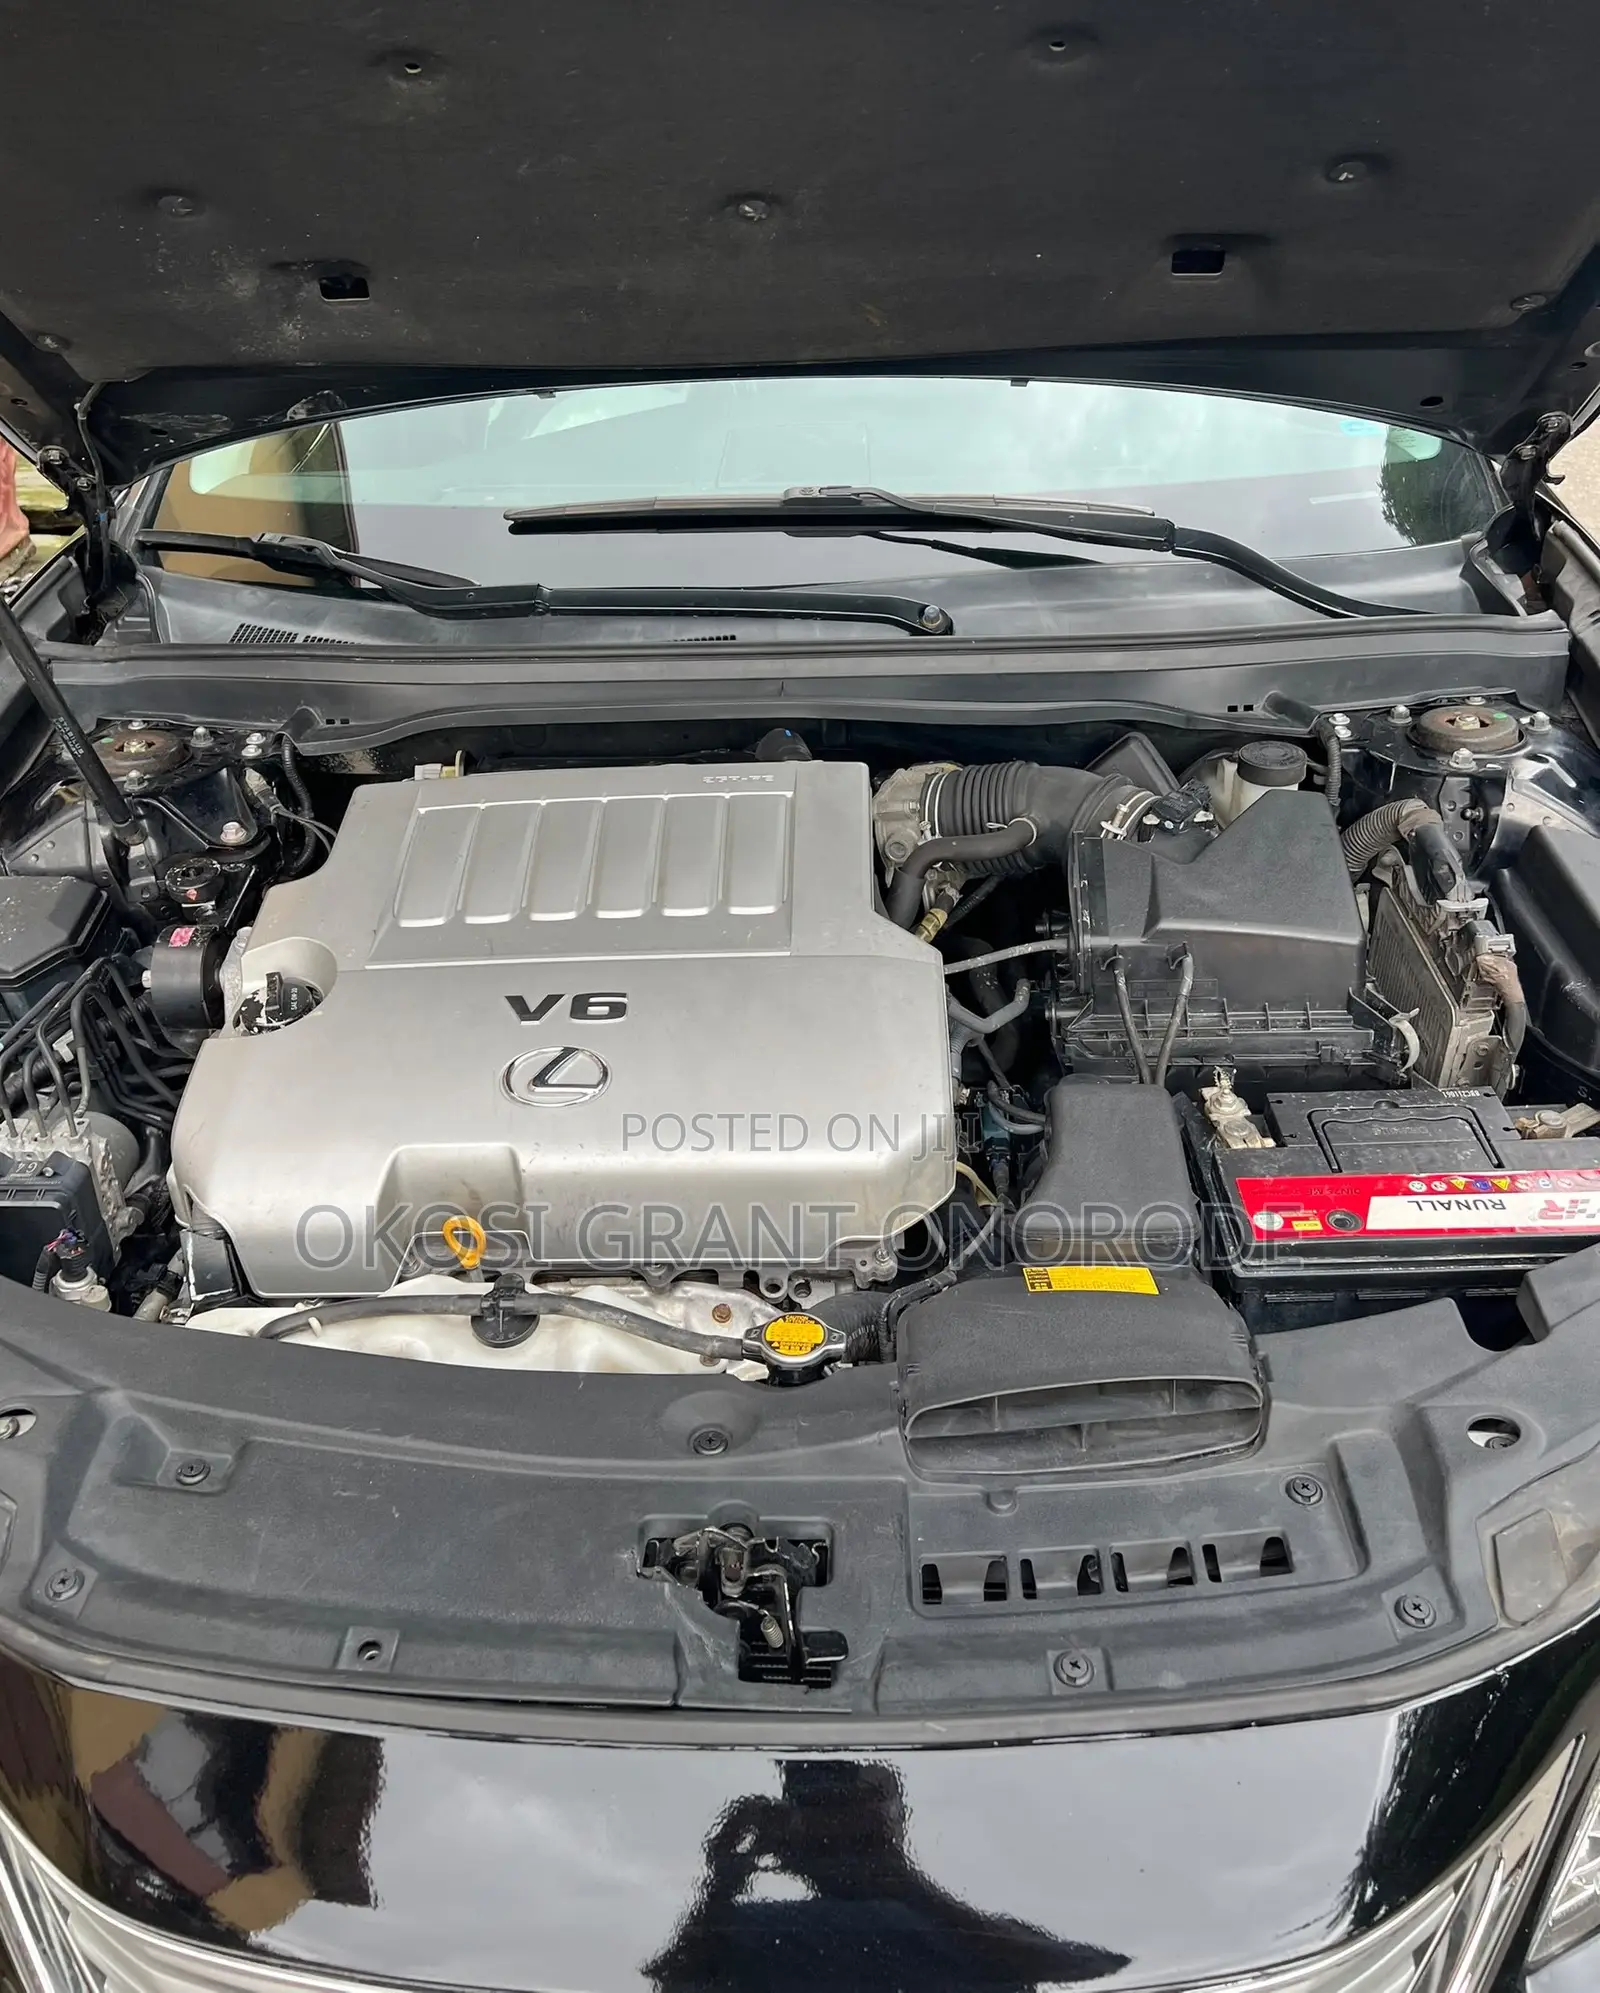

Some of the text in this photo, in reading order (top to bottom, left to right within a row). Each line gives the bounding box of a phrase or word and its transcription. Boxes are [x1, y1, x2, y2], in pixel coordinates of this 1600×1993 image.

[57, 716, 85, 754] STABILUS
[290, 1001, 298, 1010] SAE
[503, 991, 629, 1025] V6
[1407, 1198, 1507, 1211] RUNALL
